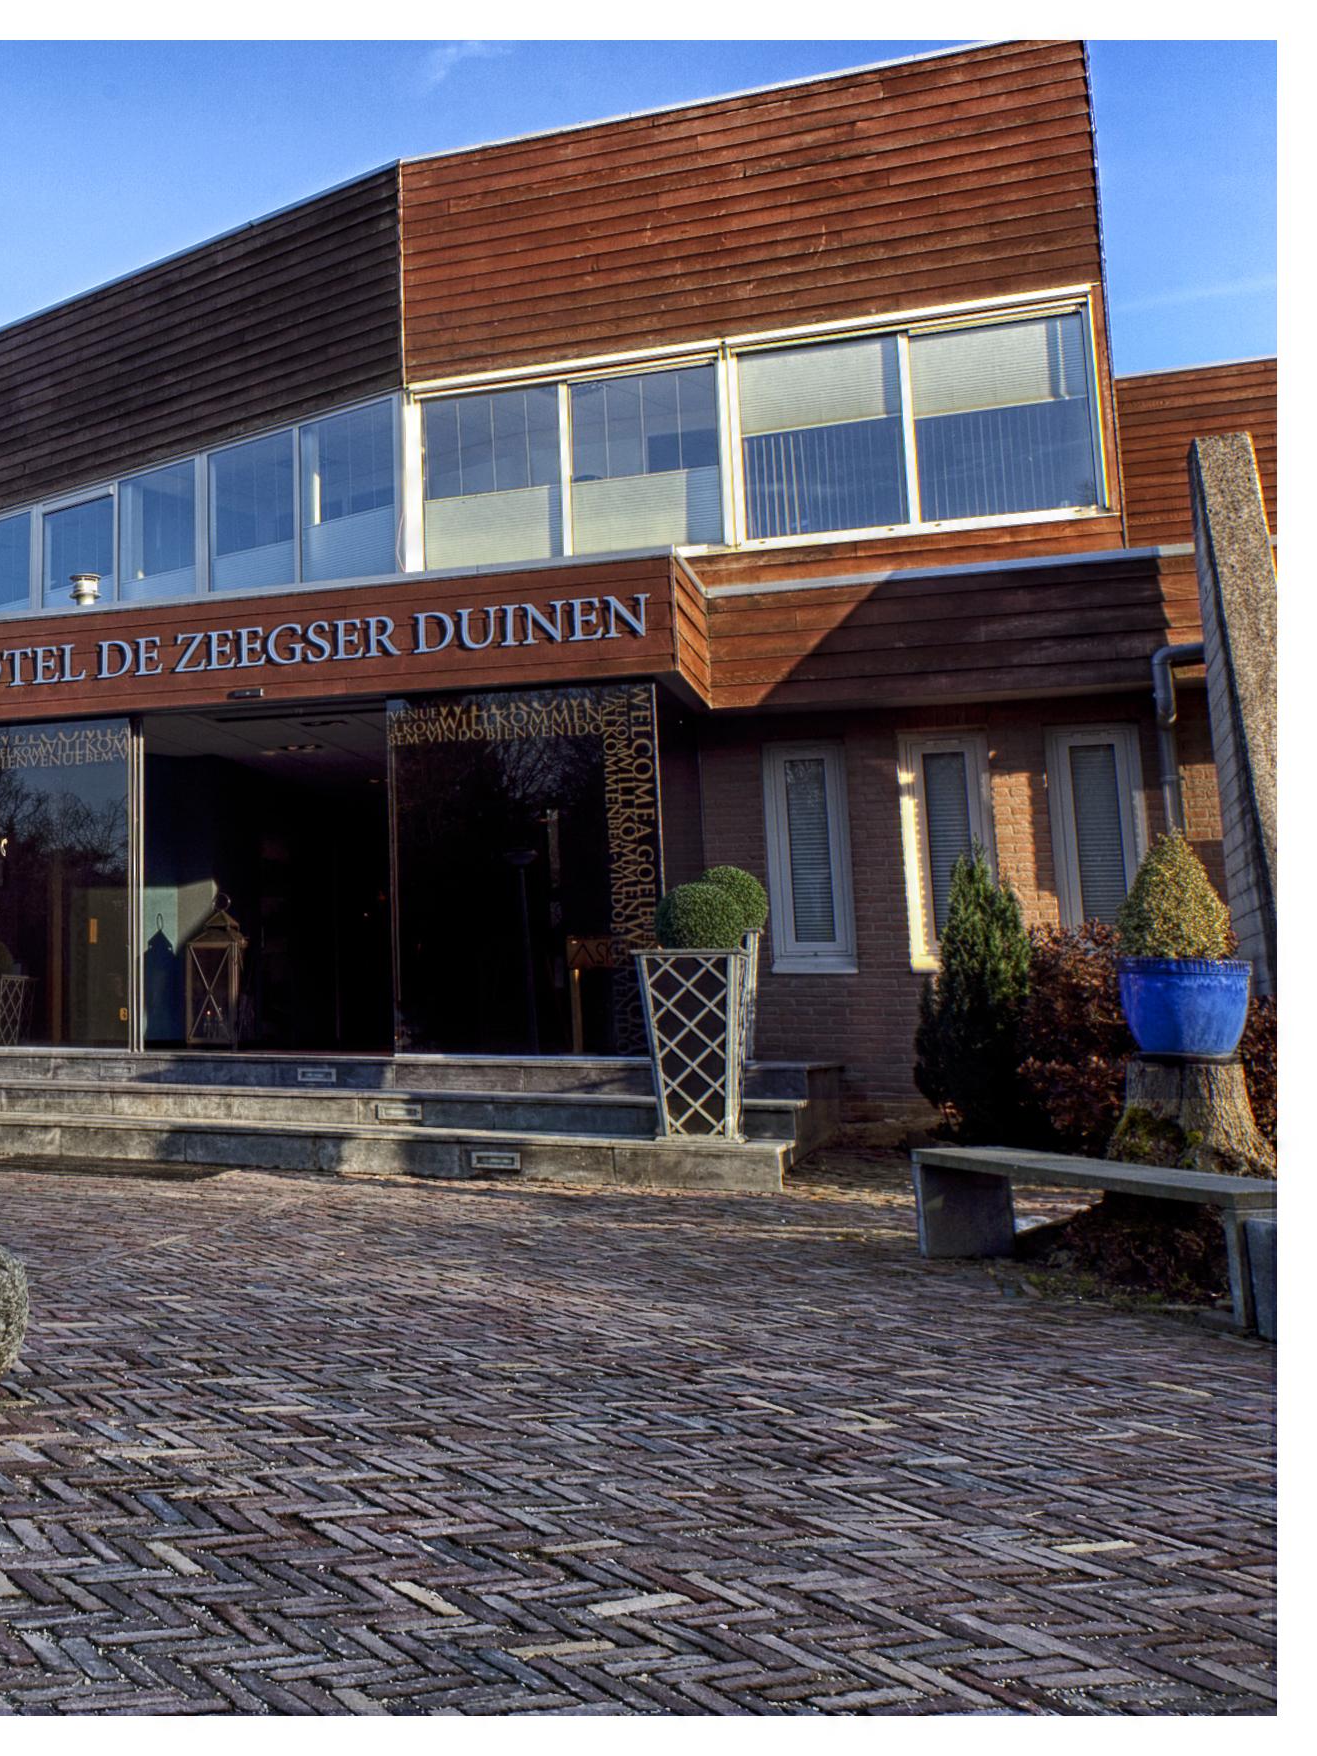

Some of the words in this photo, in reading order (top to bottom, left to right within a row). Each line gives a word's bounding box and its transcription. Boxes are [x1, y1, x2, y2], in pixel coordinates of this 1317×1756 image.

[96, 636, 164, 679] DE
[174, 615, 402, 674] ZEEGSER
[413, 593, 651, 654] DUINEN
[438, 706, 603, 731] WILLKOMMEN
[486, 721, 604, 741] BIENVENIDO
[631, 687, 655, 822] WELCOME
